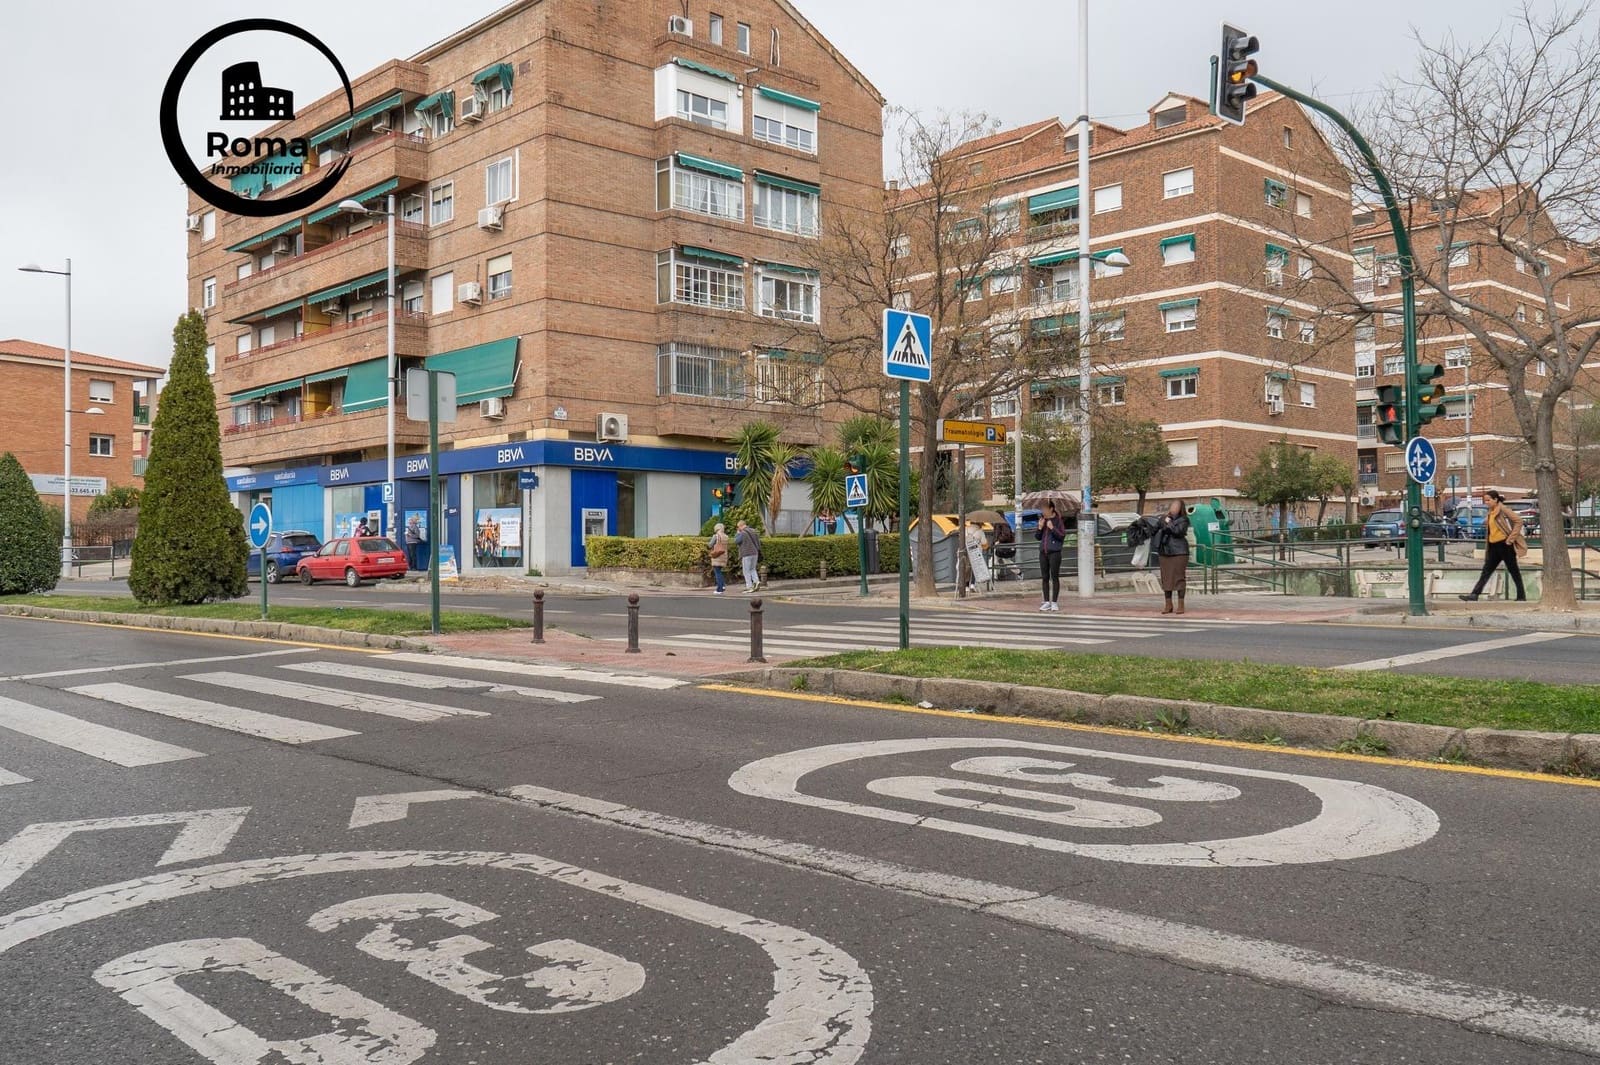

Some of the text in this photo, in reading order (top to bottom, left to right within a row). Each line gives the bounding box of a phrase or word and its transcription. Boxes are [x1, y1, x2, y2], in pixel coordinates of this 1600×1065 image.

[987, 428, 995, 440] P
[498, 446, 524, 463] BBVA
[574, 447, 614, 462] BBVA
[406, 457, 429, 472] BBVA
[330, 467, 349, 481] BBVA
[866, 756, 1242, 829] 30
